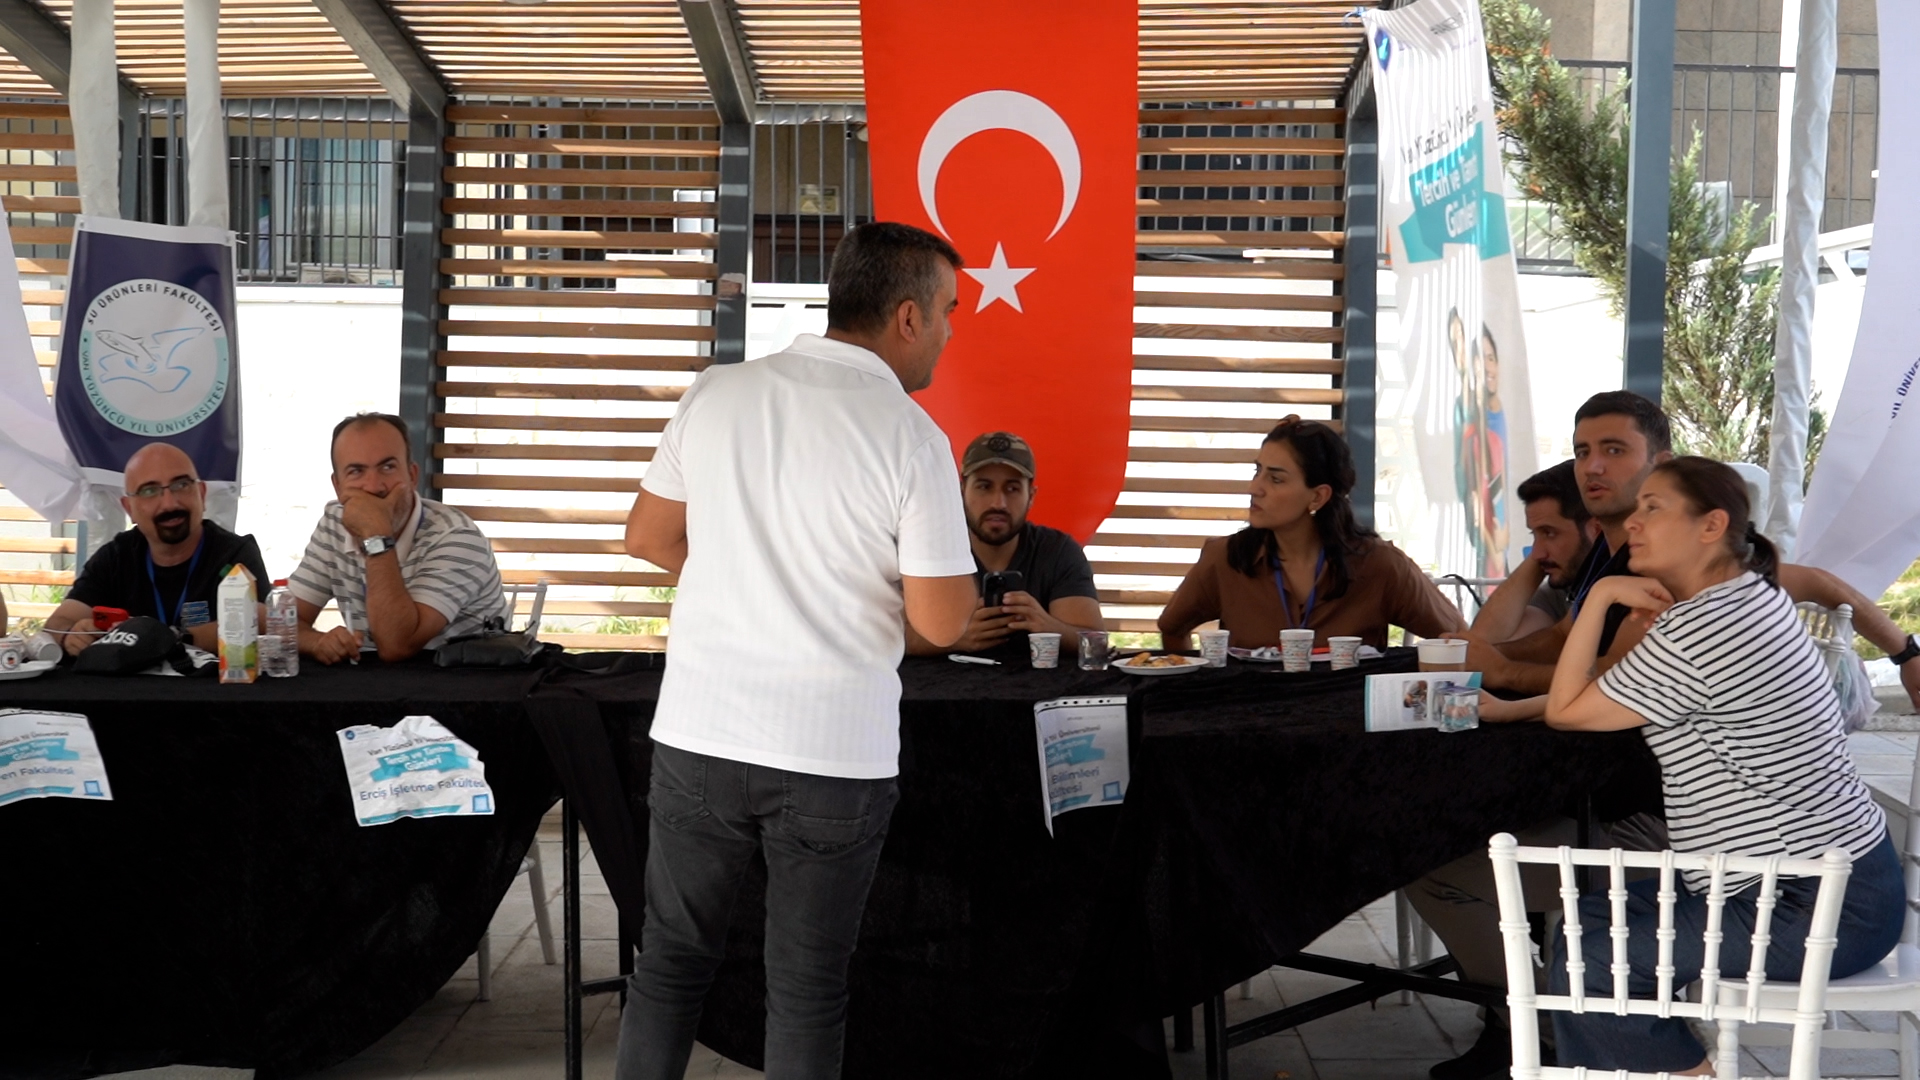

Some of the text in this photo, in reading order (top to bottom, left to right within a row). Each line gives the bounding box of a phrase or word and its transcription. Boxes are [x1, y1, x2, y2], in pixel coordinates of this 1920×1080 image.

[87, 309, 98, 325] SU
[98, 283, 158, 309] ÜRÜNLERİ
[1896, 357, 1920, 396] ÜNİVE
[85, 375, 126, 425] YÜZÜNCÜ
[130, 422, 149, 434] YIL
[20, 766, 75, 776] Fakültesi
[404, 755, 442, 771] Günleri
[1051, 766, 1099, 784] Bilimleri
[359, 787, 387, 801] Erciş
[389, 783, 434, 798] İşletme
